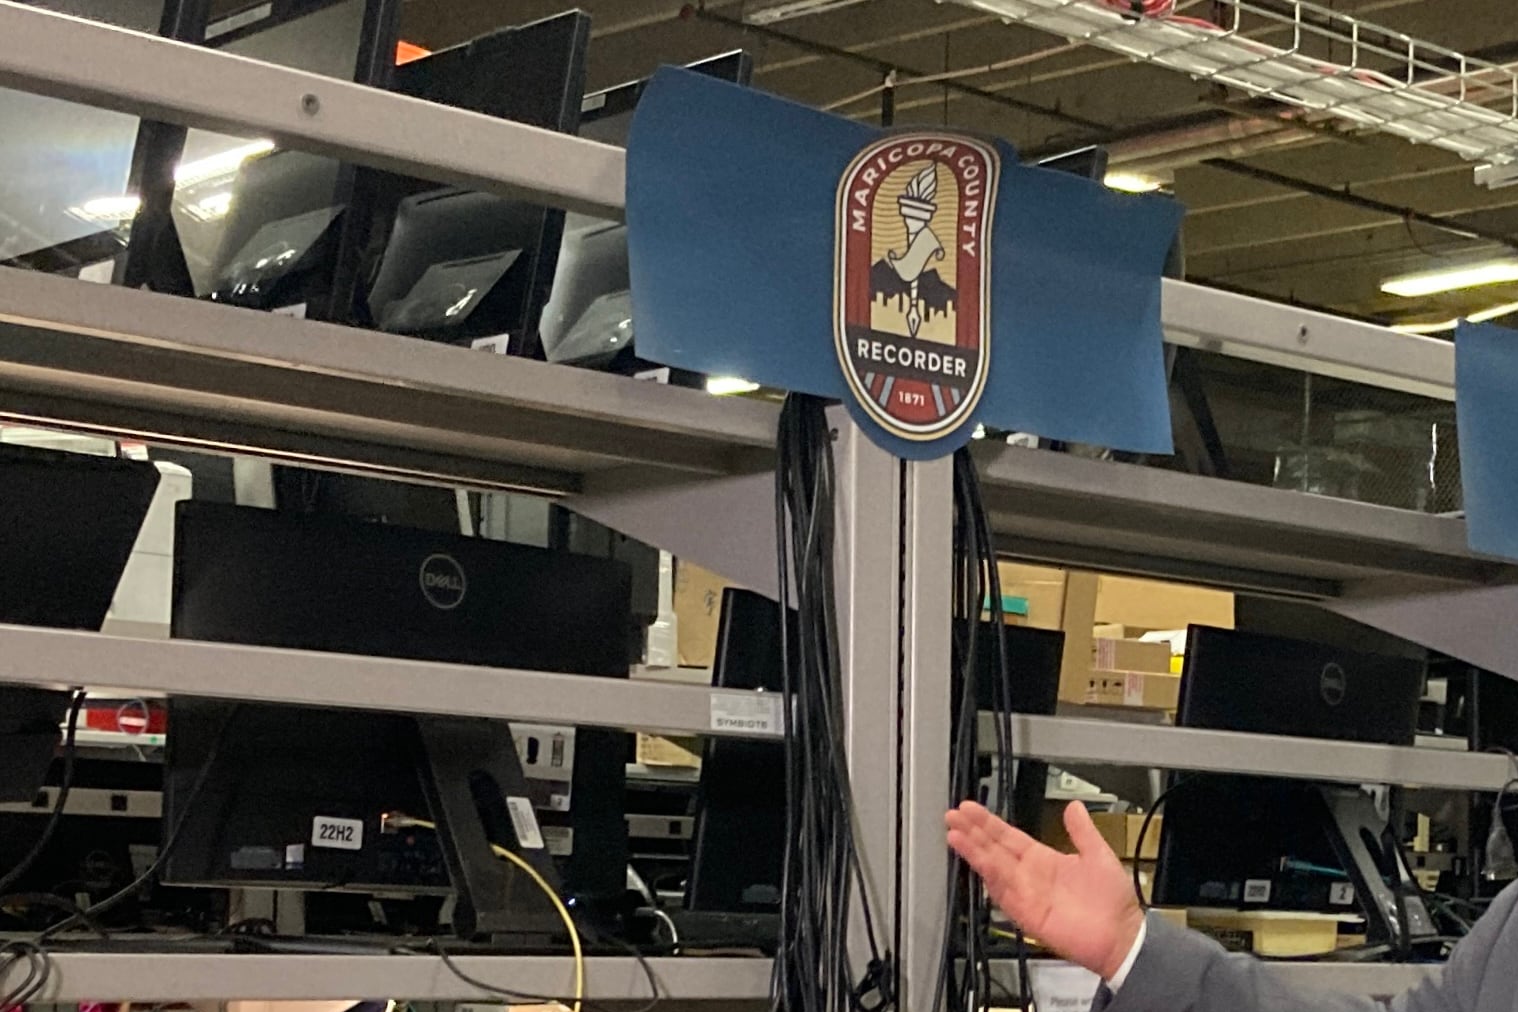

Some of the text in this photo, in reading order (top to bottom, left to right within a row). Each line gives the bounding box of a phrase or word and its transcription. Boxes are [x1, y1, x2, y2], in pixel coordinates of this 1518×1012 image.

[852, 141, 981, 258] MARICOPA COUNTY
[857, 338, 967, 378] RECORDER
[898, 390, 926, 408] 1871
[424, 572, 463, 591] DELL
[319, 823, 354, 842] 22H2
